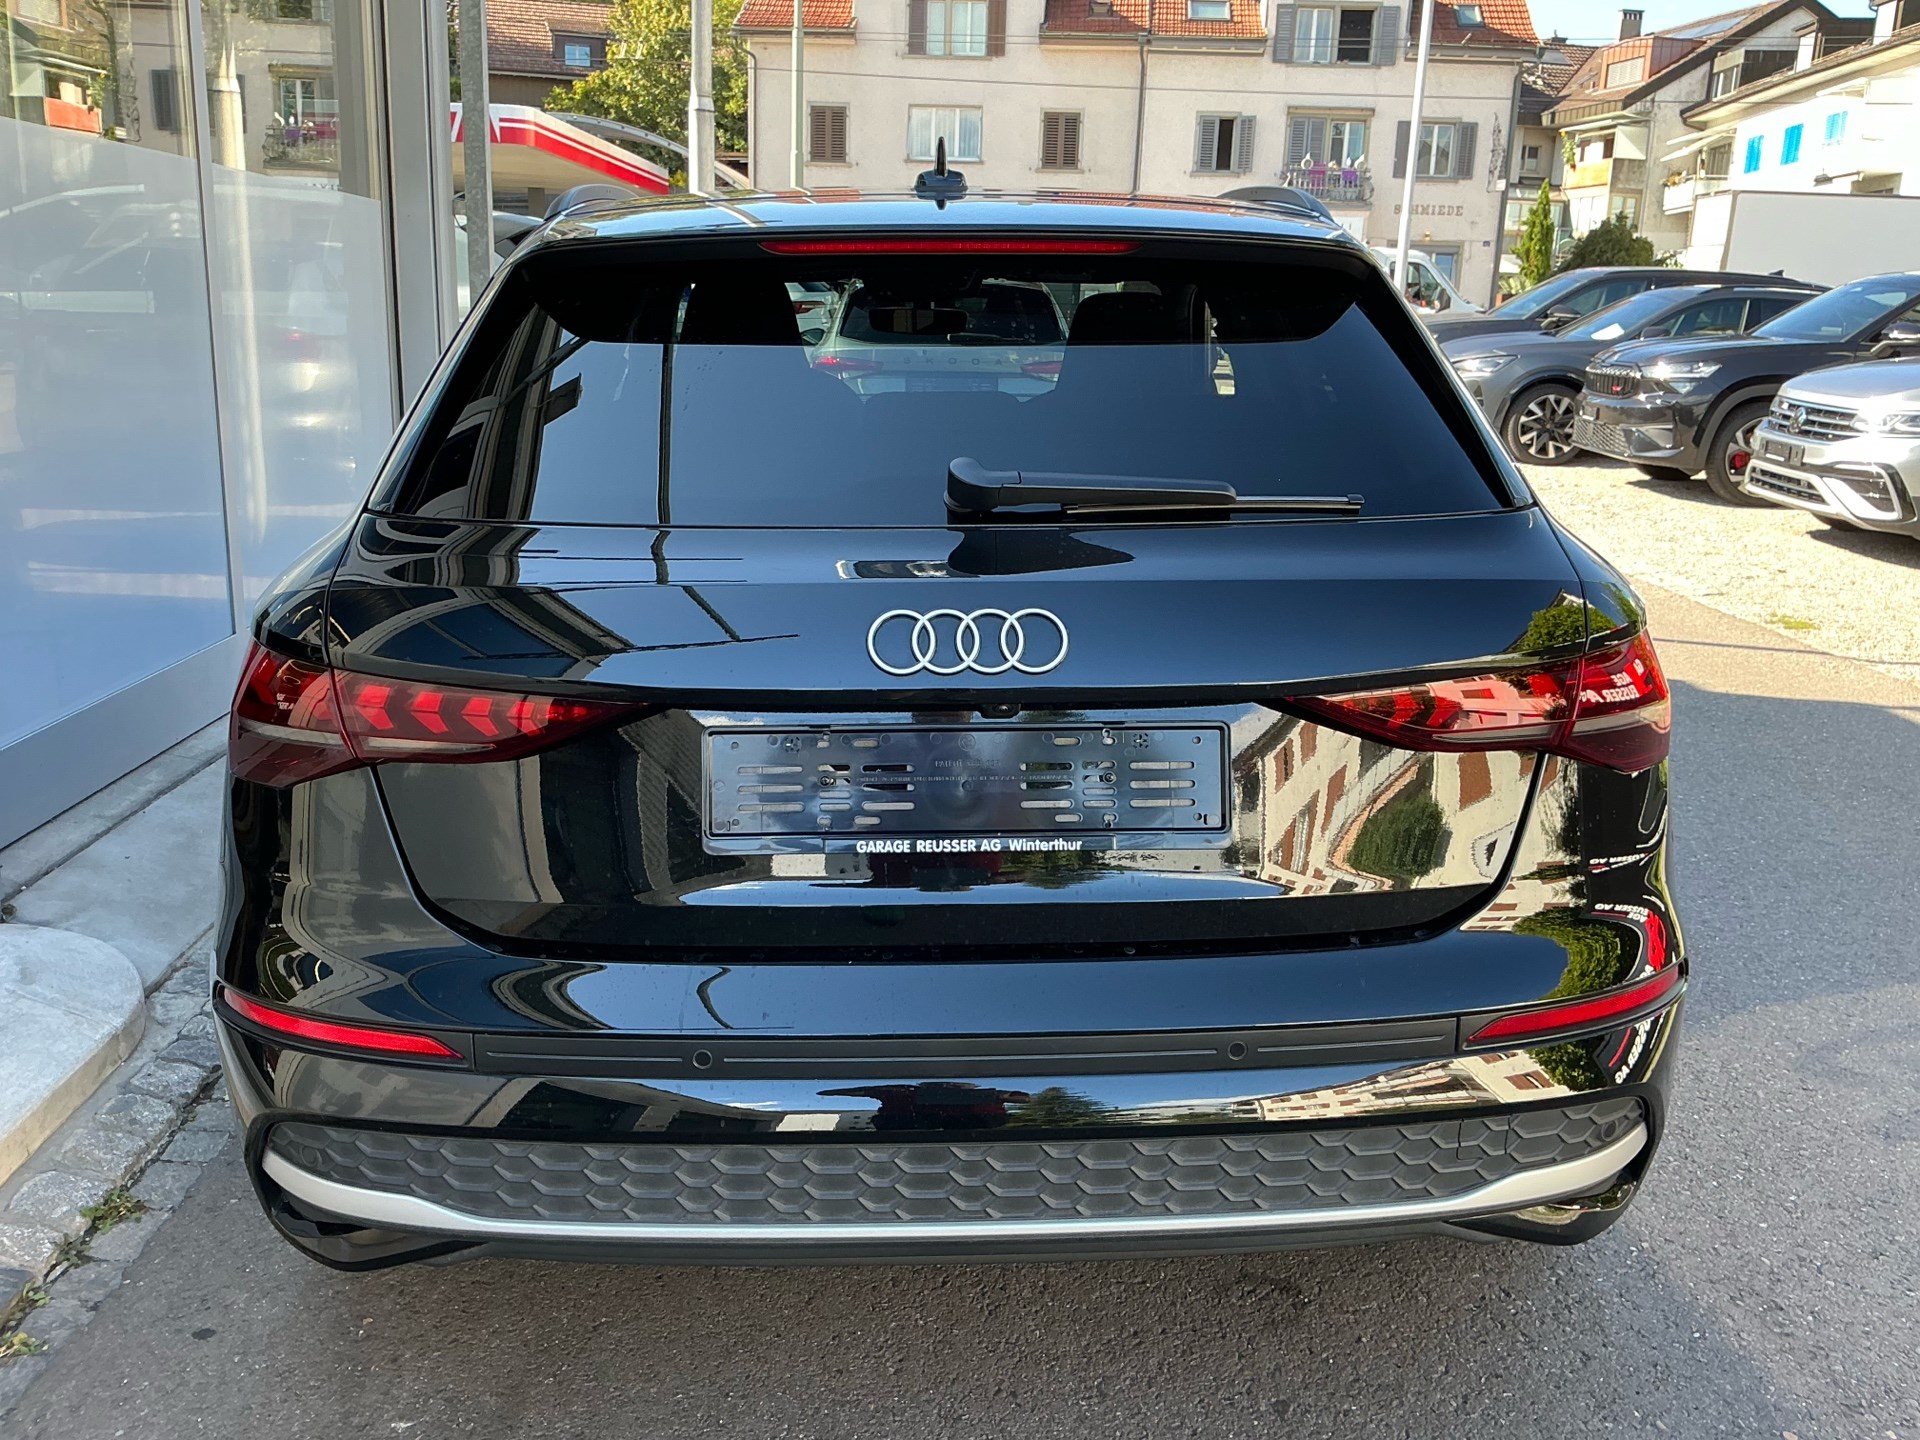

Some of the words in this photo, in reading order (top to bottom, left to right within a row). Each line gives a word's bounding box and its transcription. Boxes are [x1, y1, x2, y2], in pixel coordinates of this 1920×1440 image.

[1393, 204, 1464, 217] SHMIEDE
[856, 840, 911, 853] GARAGE
[916, 839, 976, 853] REUSSER
[980, 839, 1002, 852] AG
[1008, 838, 1083, 852] Winterthur
